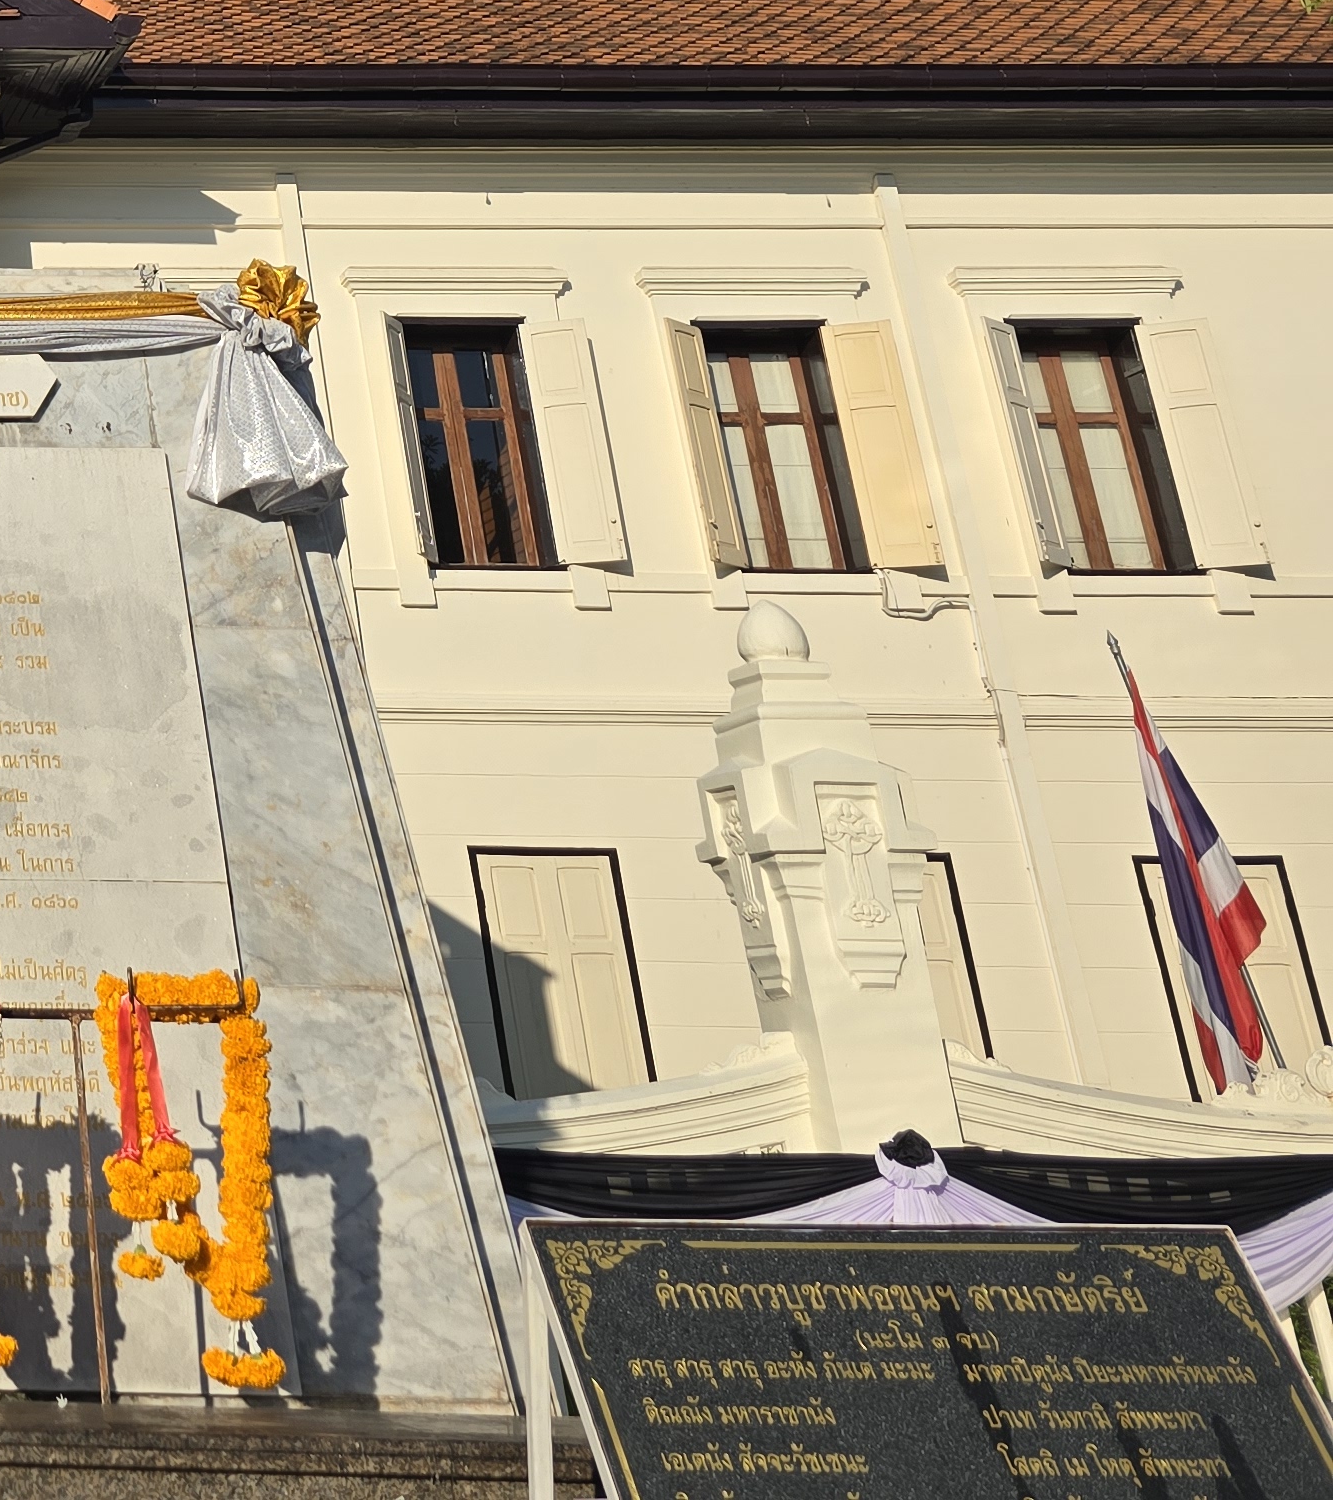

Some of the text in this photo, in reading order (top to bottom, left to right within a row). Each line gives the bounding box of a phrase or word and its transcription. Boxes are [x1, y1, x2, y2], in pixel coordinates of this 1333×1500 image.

[11, 616, 45, 637] เป็น
[15, 656, 48, 670] รวม
[5, 812, 72, 838] เมื่อทรง
[18, 849, 74, 873] ในการ
[968, 1268, 1149, 1313] สามกษัตริย์
[857, 1320, 921, 1351] (นะโม
[628, 1356, 672, 1388] สาธุ
[673, 1357, 718, 1389] สาธุ
[720, 1359, 764, 1390] สาธุ
[765, 1351, 817, 1379] อะหัง
[643, 1398, 1207, 1430] ติณณัง มหาราชานัง ปาเท วันทามิ สัพพะทา
[661, 1442, 1231, 1488] เอเตนัง สัจจะวัชเชนะ โสตถิ เม โหตุ สัพพะทา
